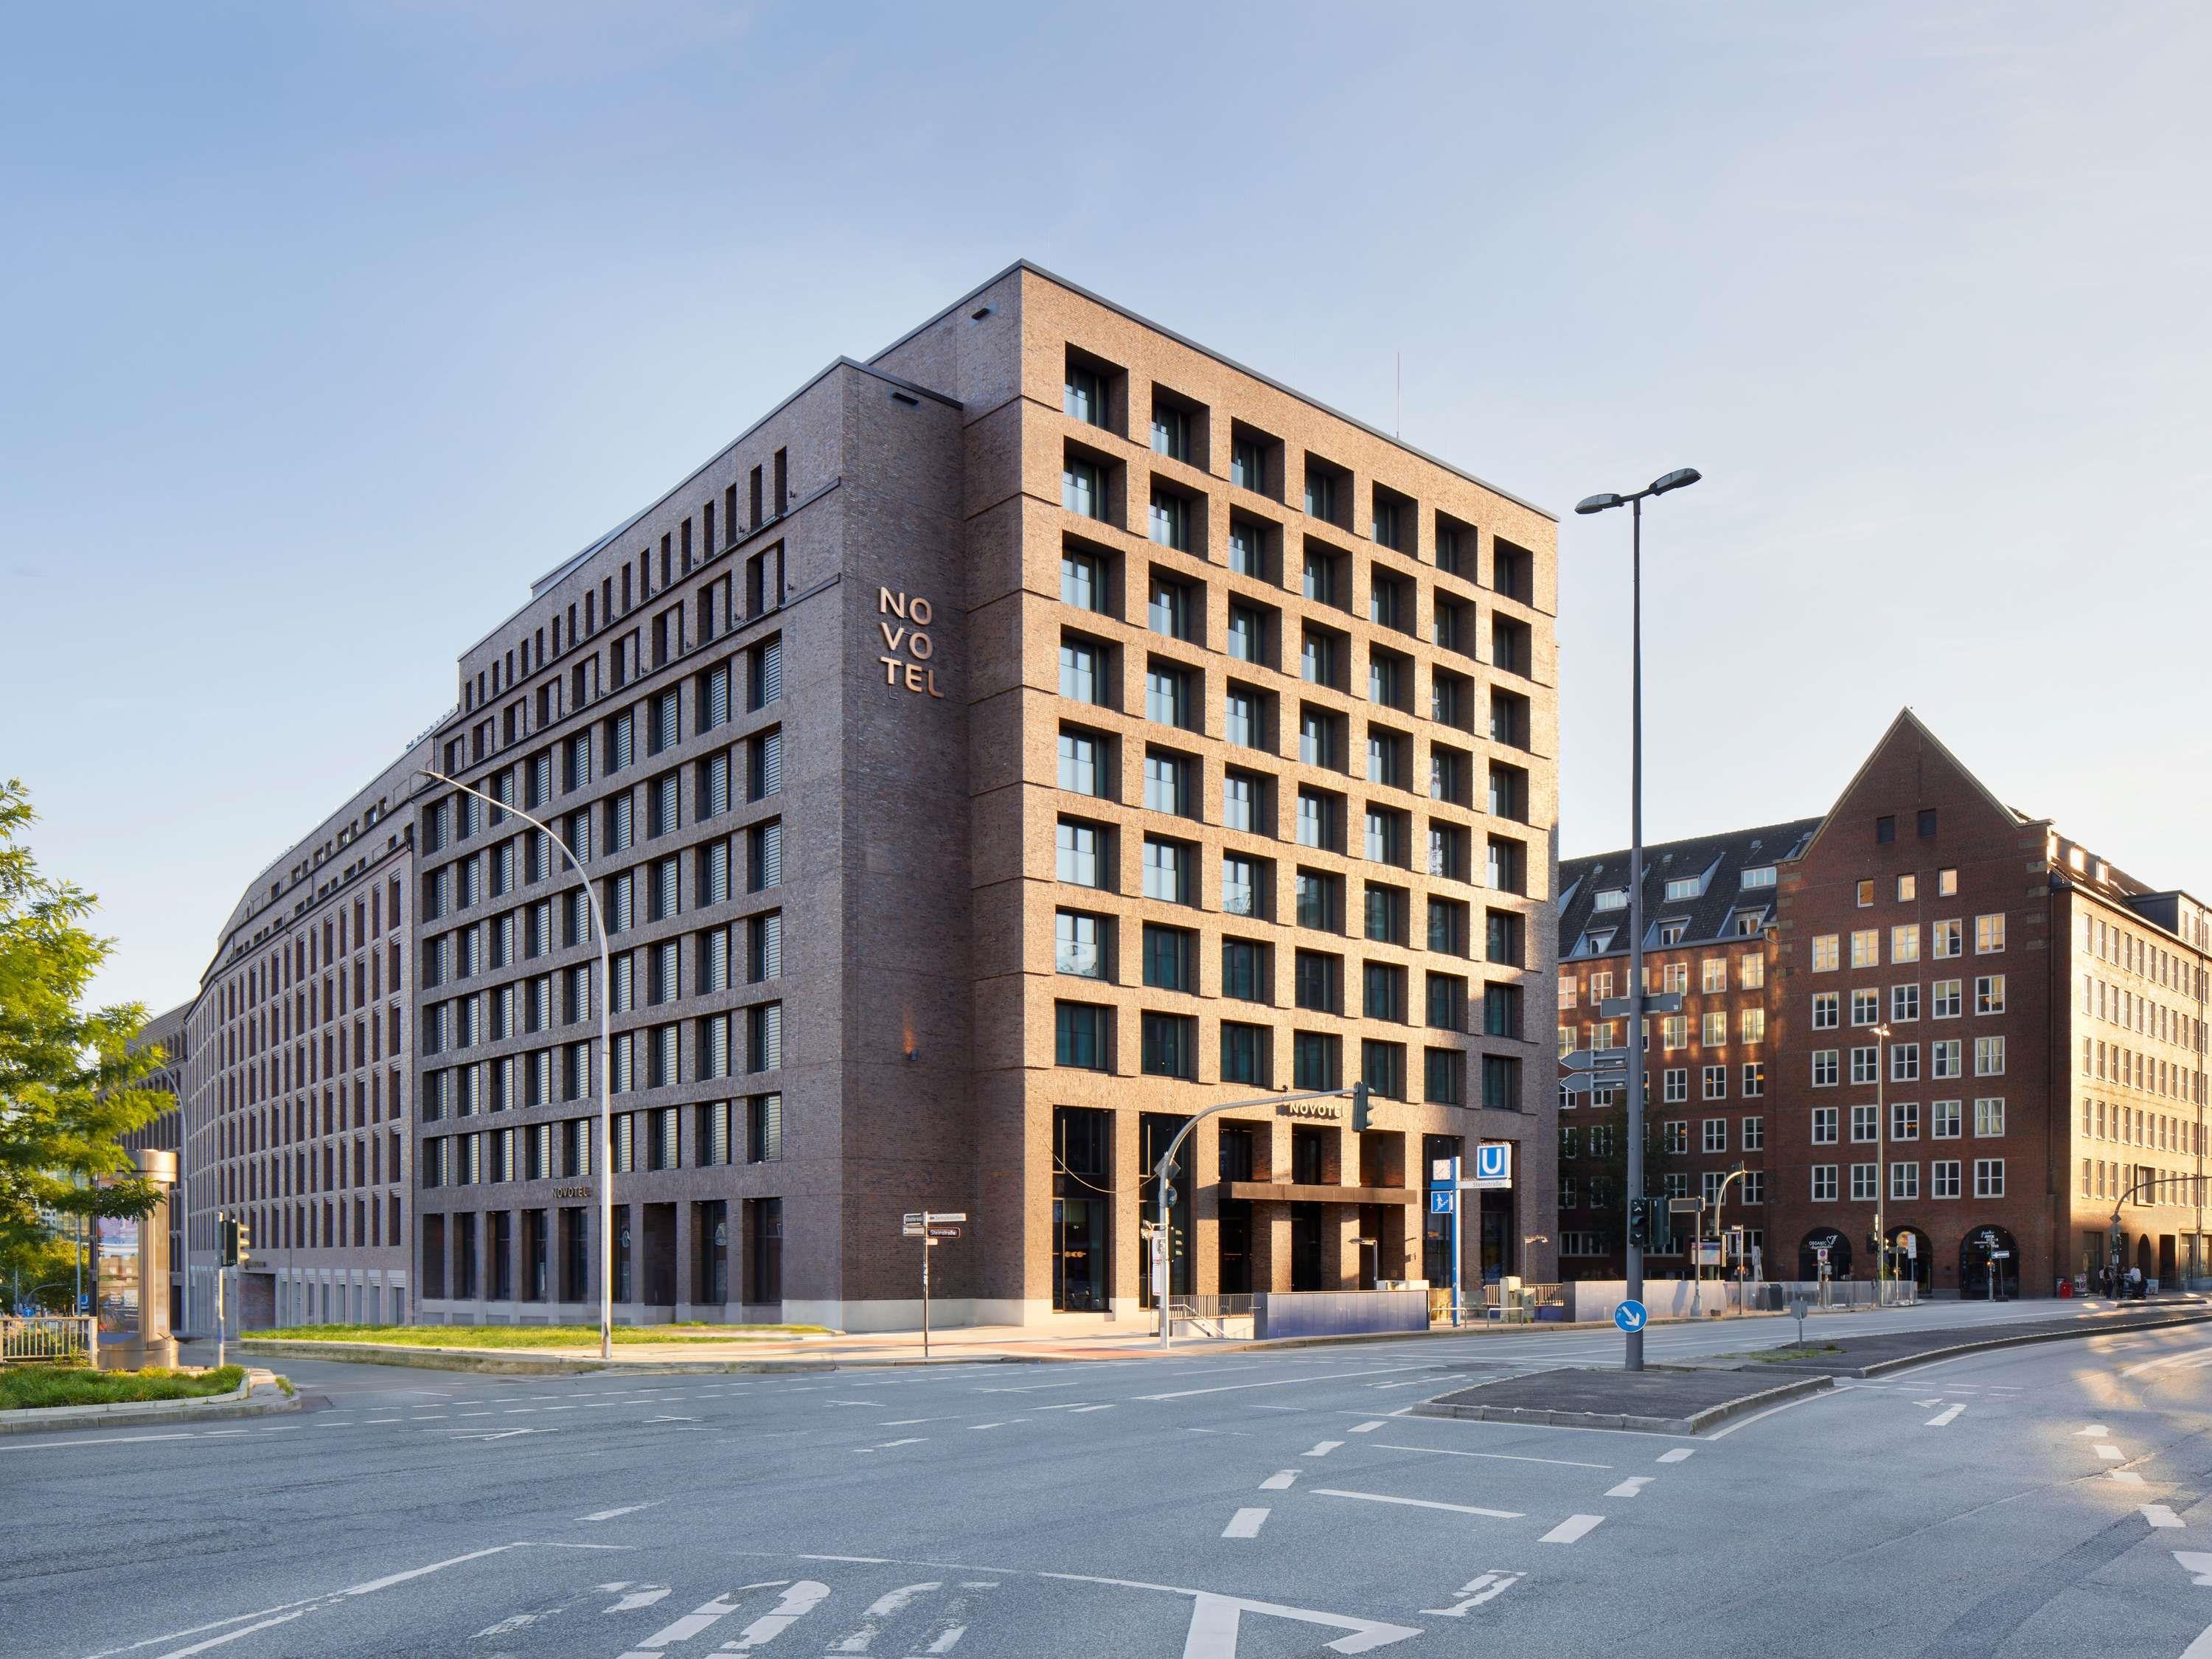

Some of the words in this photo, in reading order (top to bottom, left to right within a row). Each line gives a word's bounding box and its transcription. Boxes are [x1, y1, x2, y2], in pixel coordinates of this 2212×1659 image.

[880, 587, 932, 625] NO
[881, 622, 932, 659] VO
[880, 656, 945, 698] TEL
[1290, 1103, 1347, 1117] NOVOTEL
[1482, 1149, 1501, 1174] U
[552, 1186, 588, 1198] NOVOTEL
